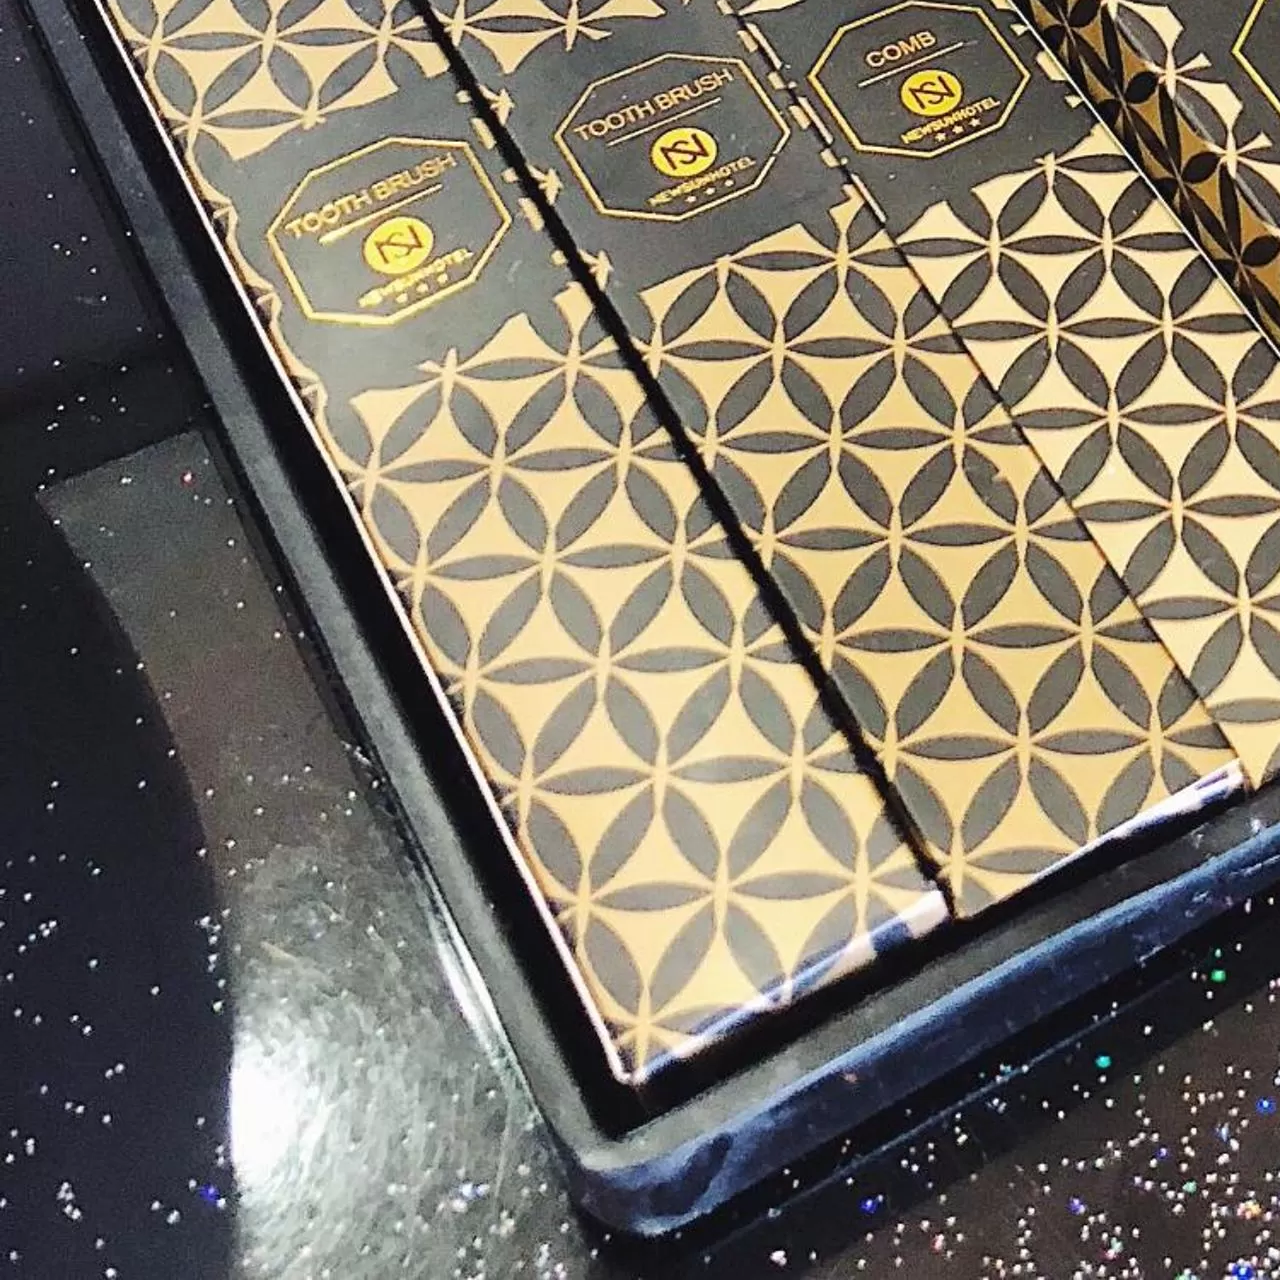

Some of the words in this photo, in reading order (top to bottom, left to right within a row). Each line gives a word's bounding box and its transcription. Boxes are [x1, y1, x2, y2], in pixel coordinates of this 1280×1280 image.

[865, 30, 937, 68] COMB
[573, 99, 656, 141] TOOTH
[653, 68, 734, 111] BRUSH
[285, 192, 373, 238] TOOTH
[370, 152, 457, 200] BRUSH
